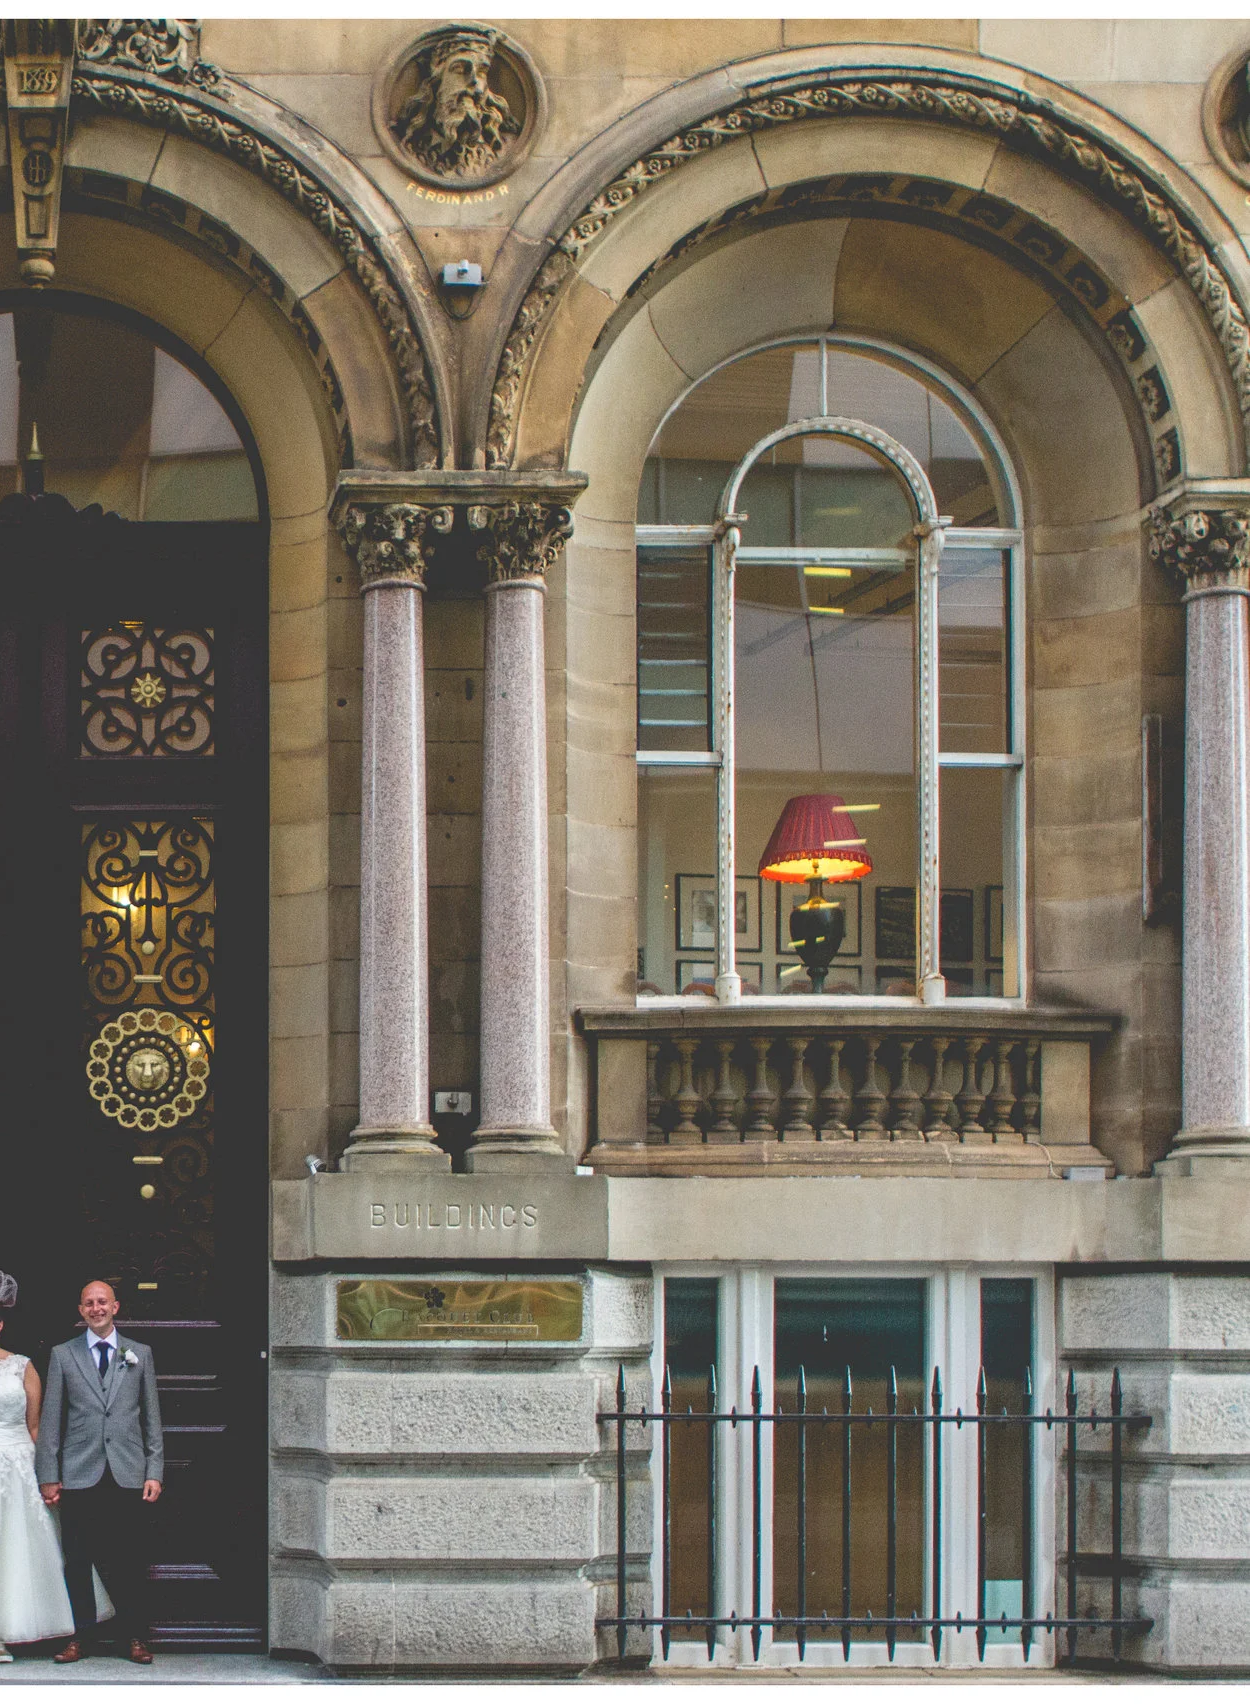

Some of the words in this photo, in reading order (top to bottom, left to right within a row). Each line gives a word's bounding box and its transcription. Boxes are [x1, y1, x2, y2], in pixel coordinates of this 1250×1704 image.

[406, 182, 495, 205] FERDINAND
[498, 184, 509, 196] R
[370, 1203, 539, 1229] BUILDINGS
